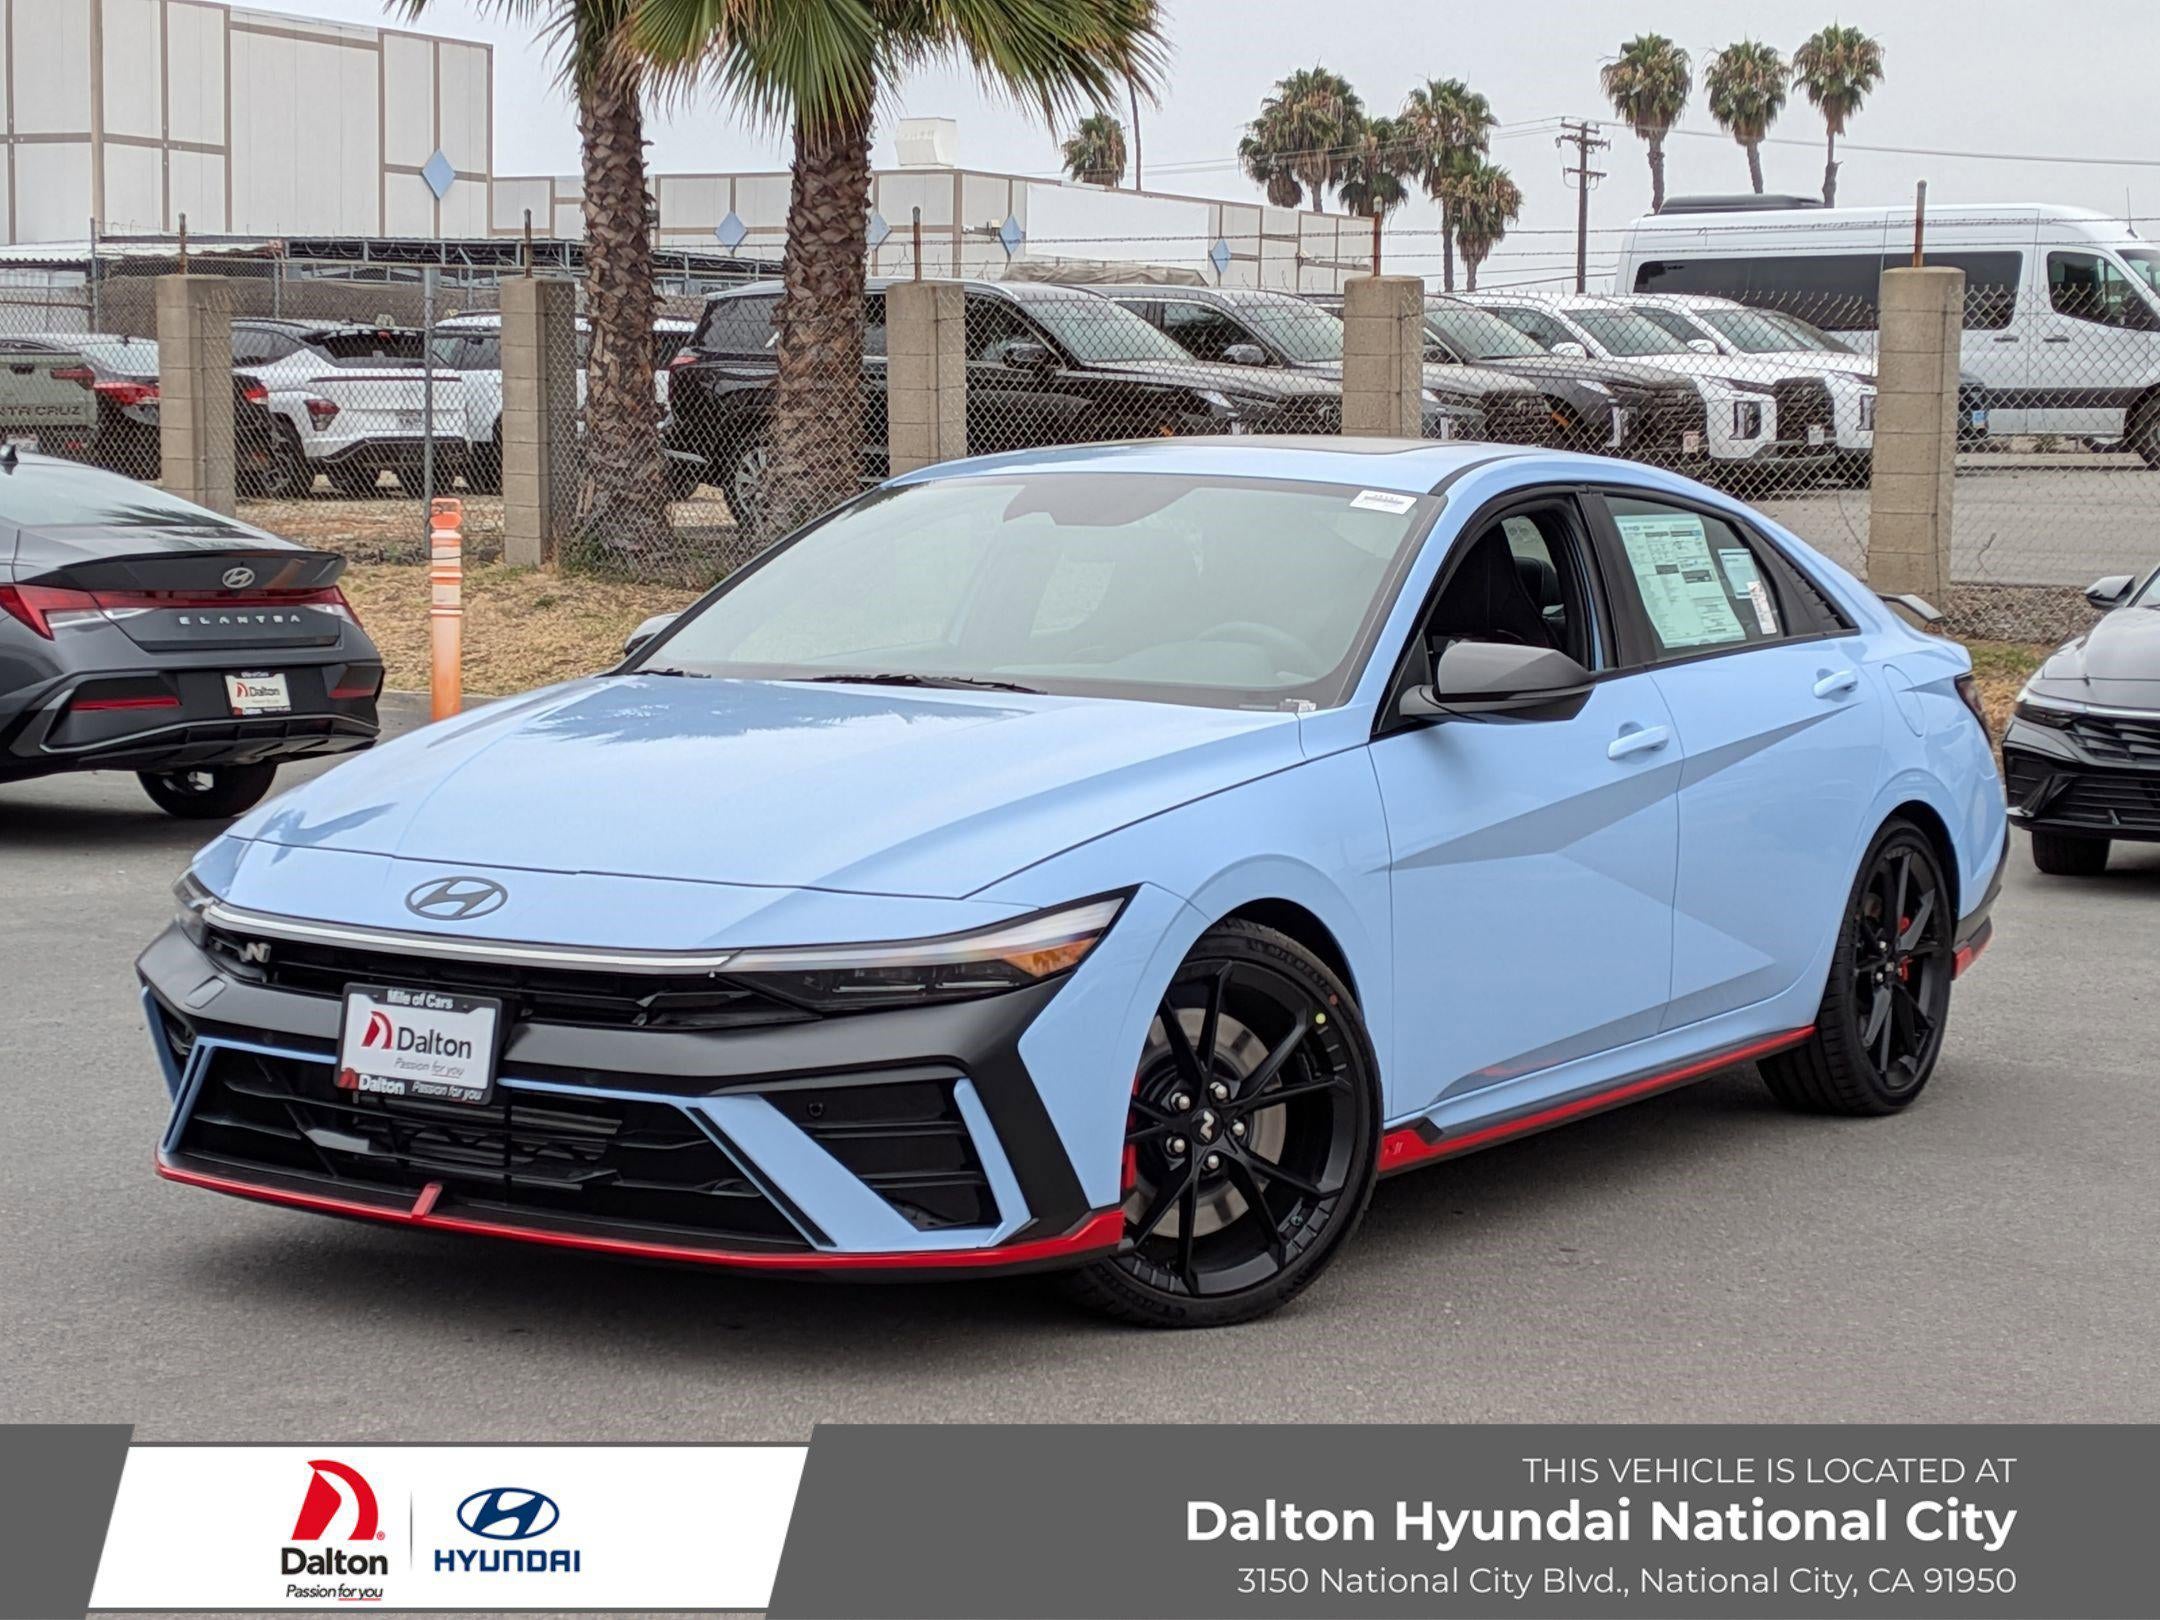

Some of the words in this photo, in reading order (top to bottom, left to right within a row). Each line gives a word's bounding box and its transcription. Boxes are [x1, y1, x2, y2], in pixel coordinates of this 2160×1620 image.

[35, 406, 80, 416] CRUZ
[179, 615, 300, 625] ELANTRA
[249, 686, 280, 697] Dalton
[387, 989, 411, 1005] Mile
[412, 992, 426, 1006] of
[426, 994, 454, 1009] Cars
[397, 1027, 472, 1059] Dalton
[395, 1057, 430, 1071] Passion
[431, 1060, 446, 1073] for
[446, 1065, 465, 1077] you
[358, 1074, 406, 1096] Dalton
[411, 1081, 449, 1096] Passion
[448, 1084, 463, 1098] for
[462, 1088, 483, 1101] you
